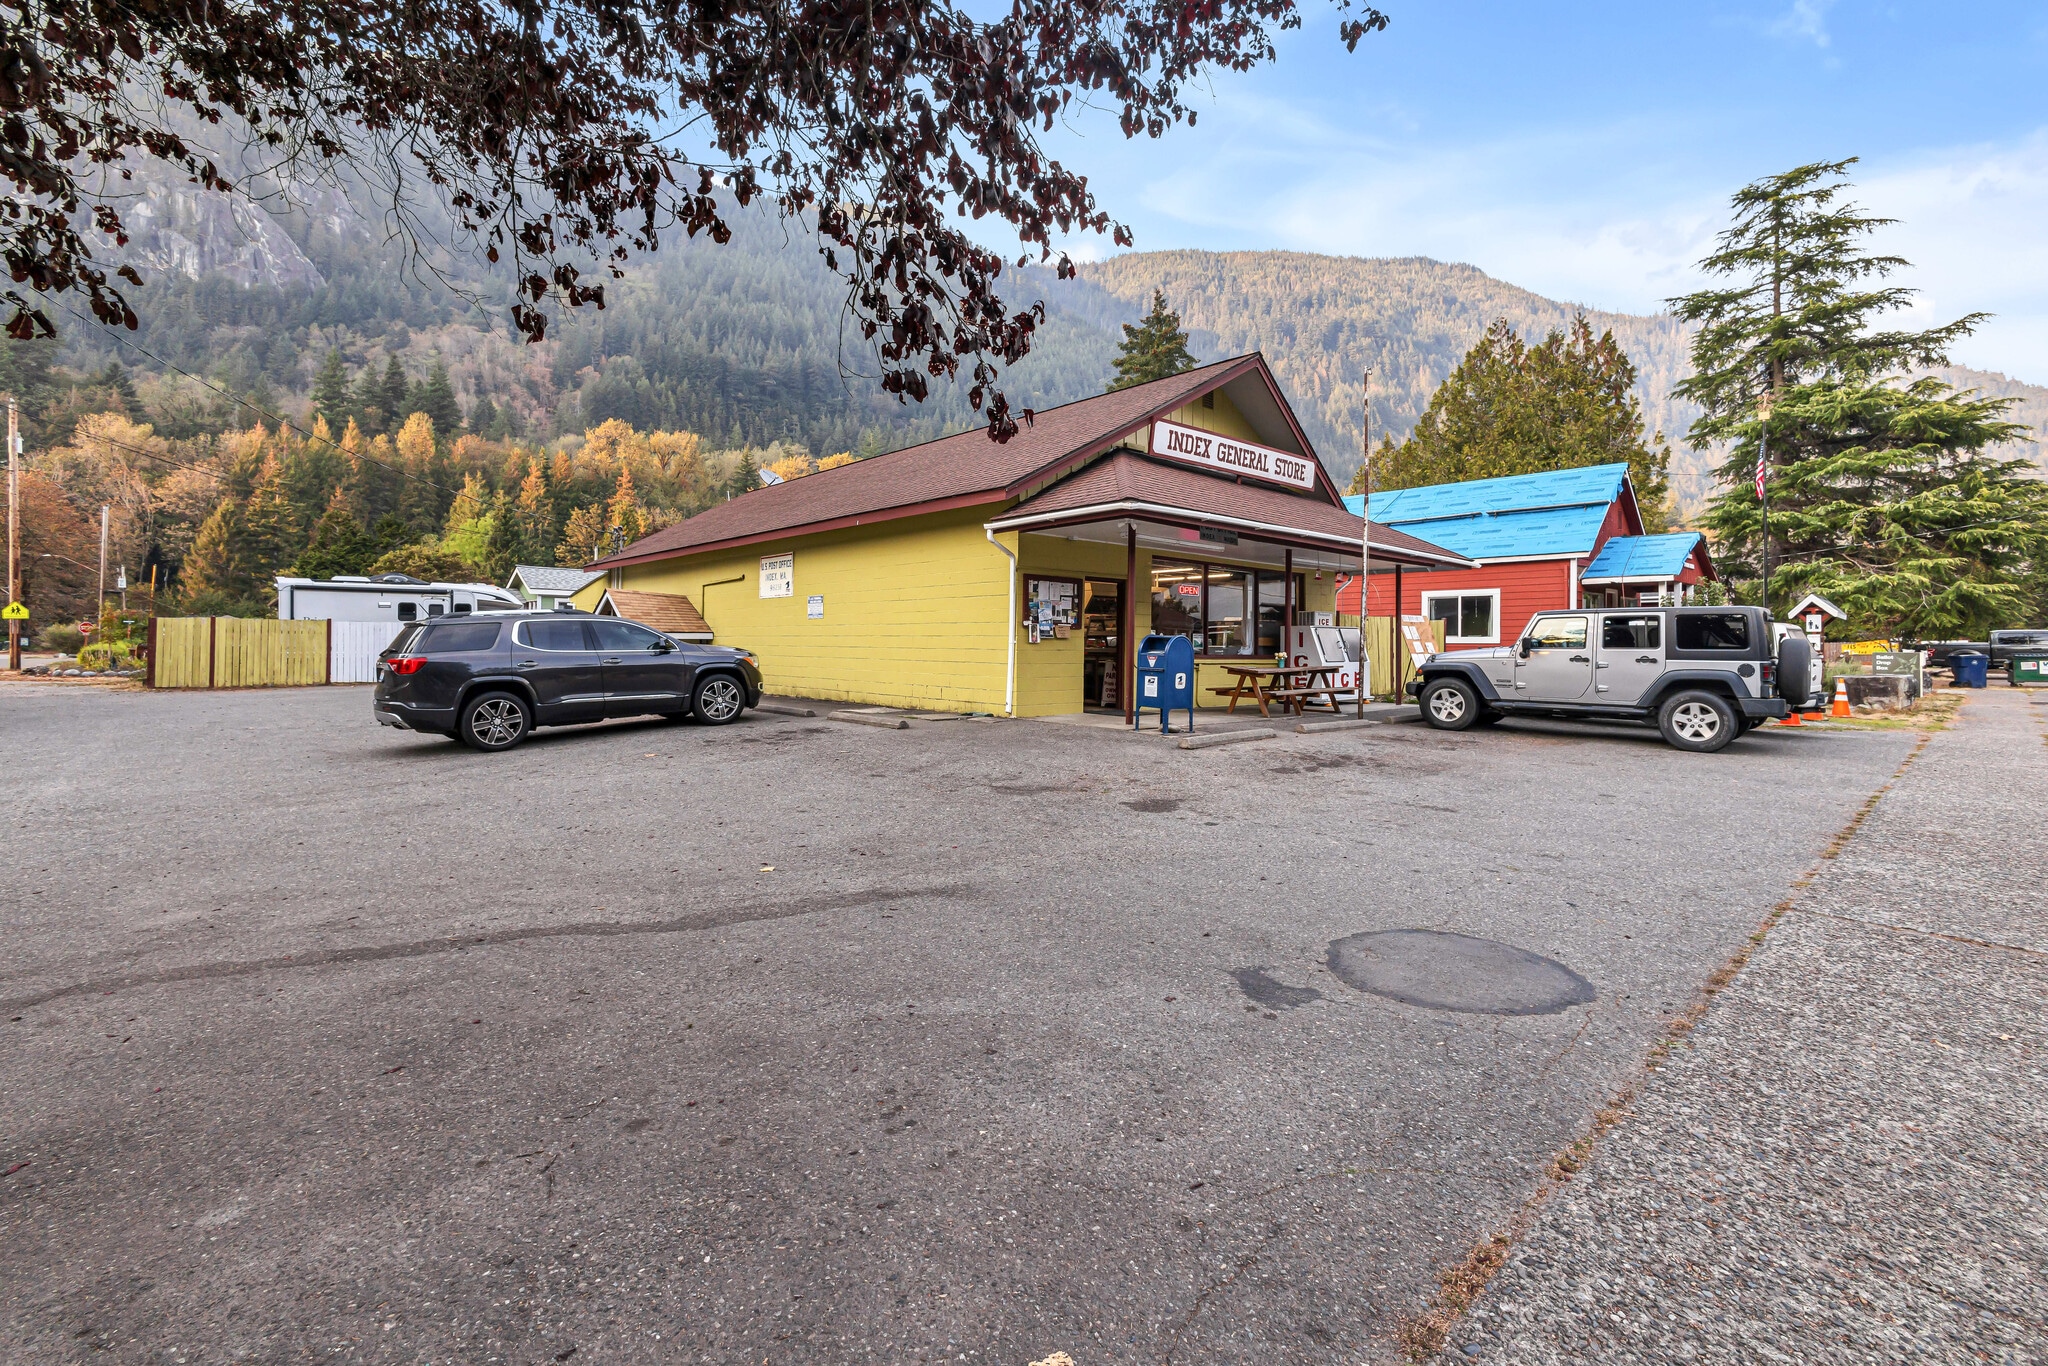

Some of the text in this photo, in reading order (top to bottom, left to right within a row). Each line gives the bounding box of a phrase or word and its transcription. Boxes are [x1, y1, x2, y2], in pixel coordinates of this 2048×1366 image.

[1167, 430, 1306, 482] INDEX GENERAL STORE
[768, 561, 778, 570] POST
[779, 560, 792, 568] OFFICE
[1179, 585, 1199, 595] OPEN
[1318, 618, 1329, 626] ICE
